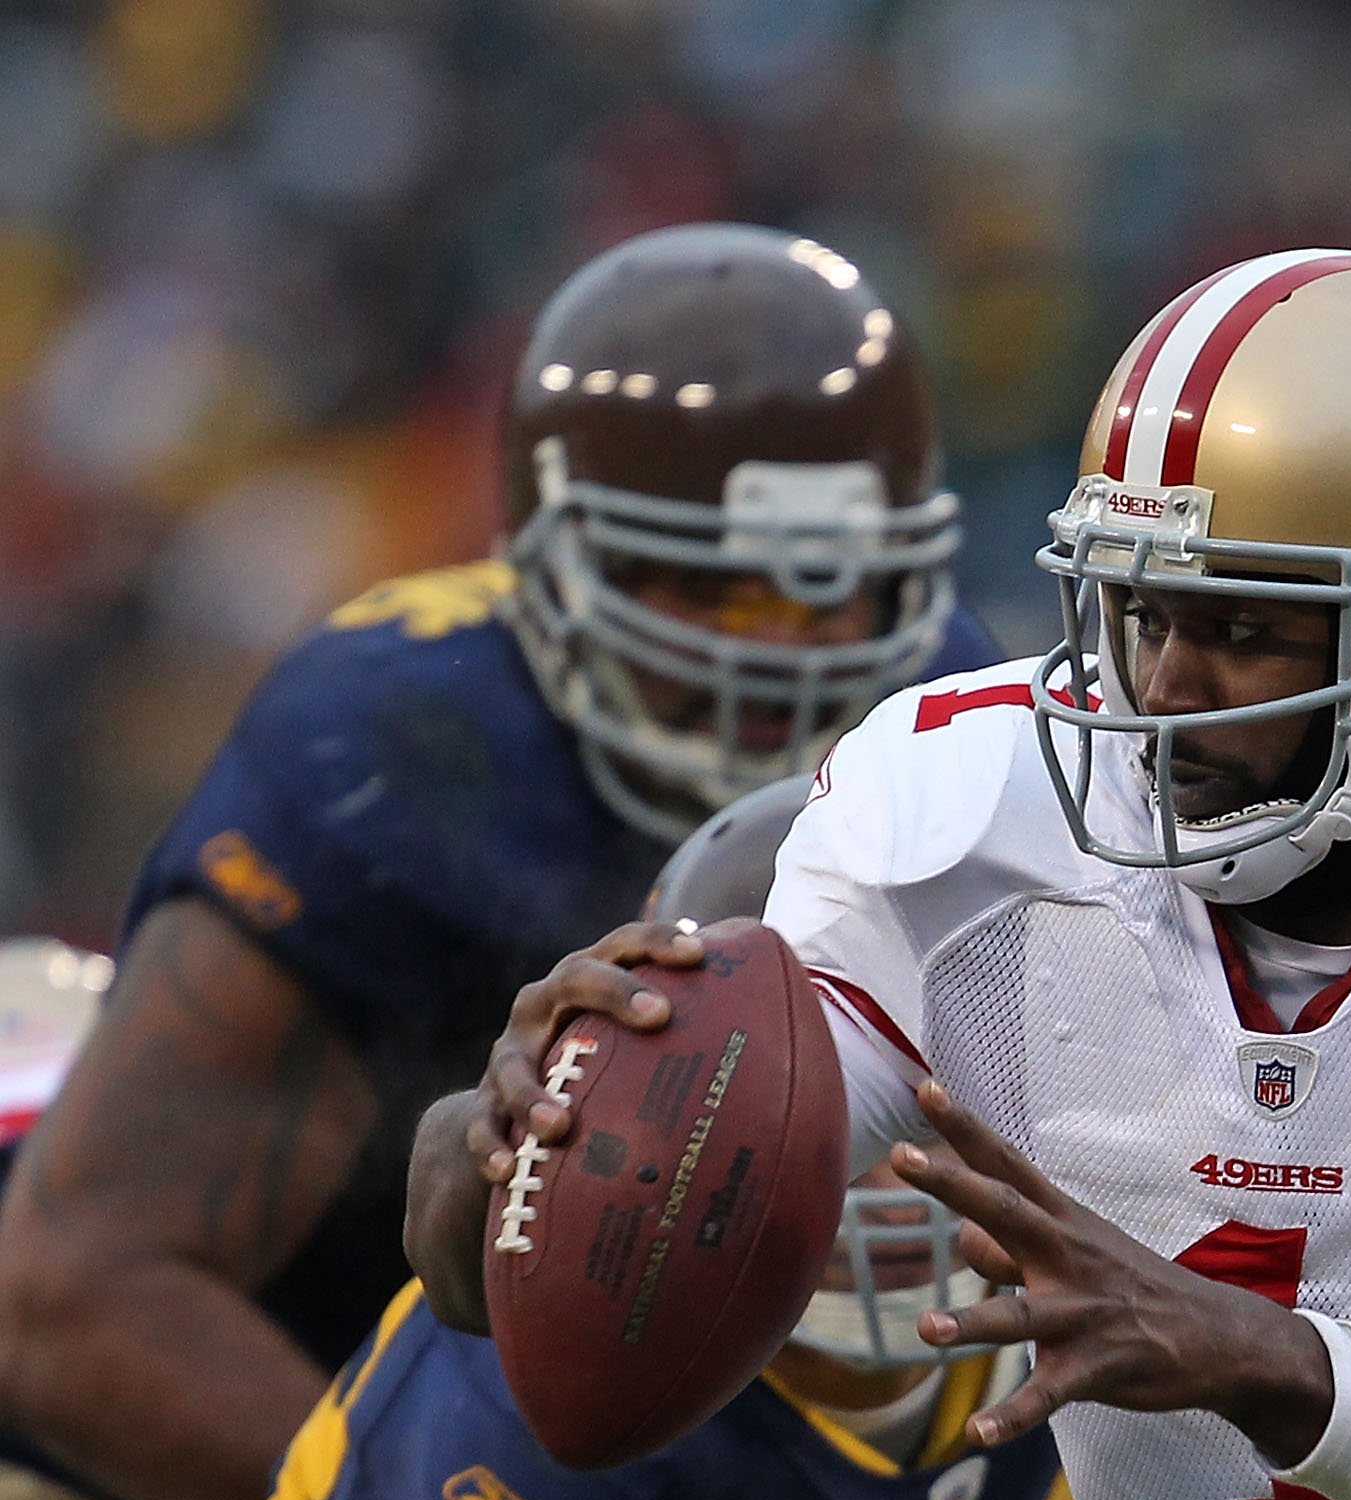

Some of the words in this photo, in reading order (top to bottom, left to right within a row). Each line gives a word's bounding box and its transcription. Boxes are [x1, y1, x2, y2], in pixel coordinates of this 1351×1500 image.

[1258, 1081, 1291, 1106] NFL
[659, 1112, 715, 1229] FOOTBALL
[703, 1028, 748, 1110] LEAGUE
[1189, 1153, 1344, 1195] 49ERS
